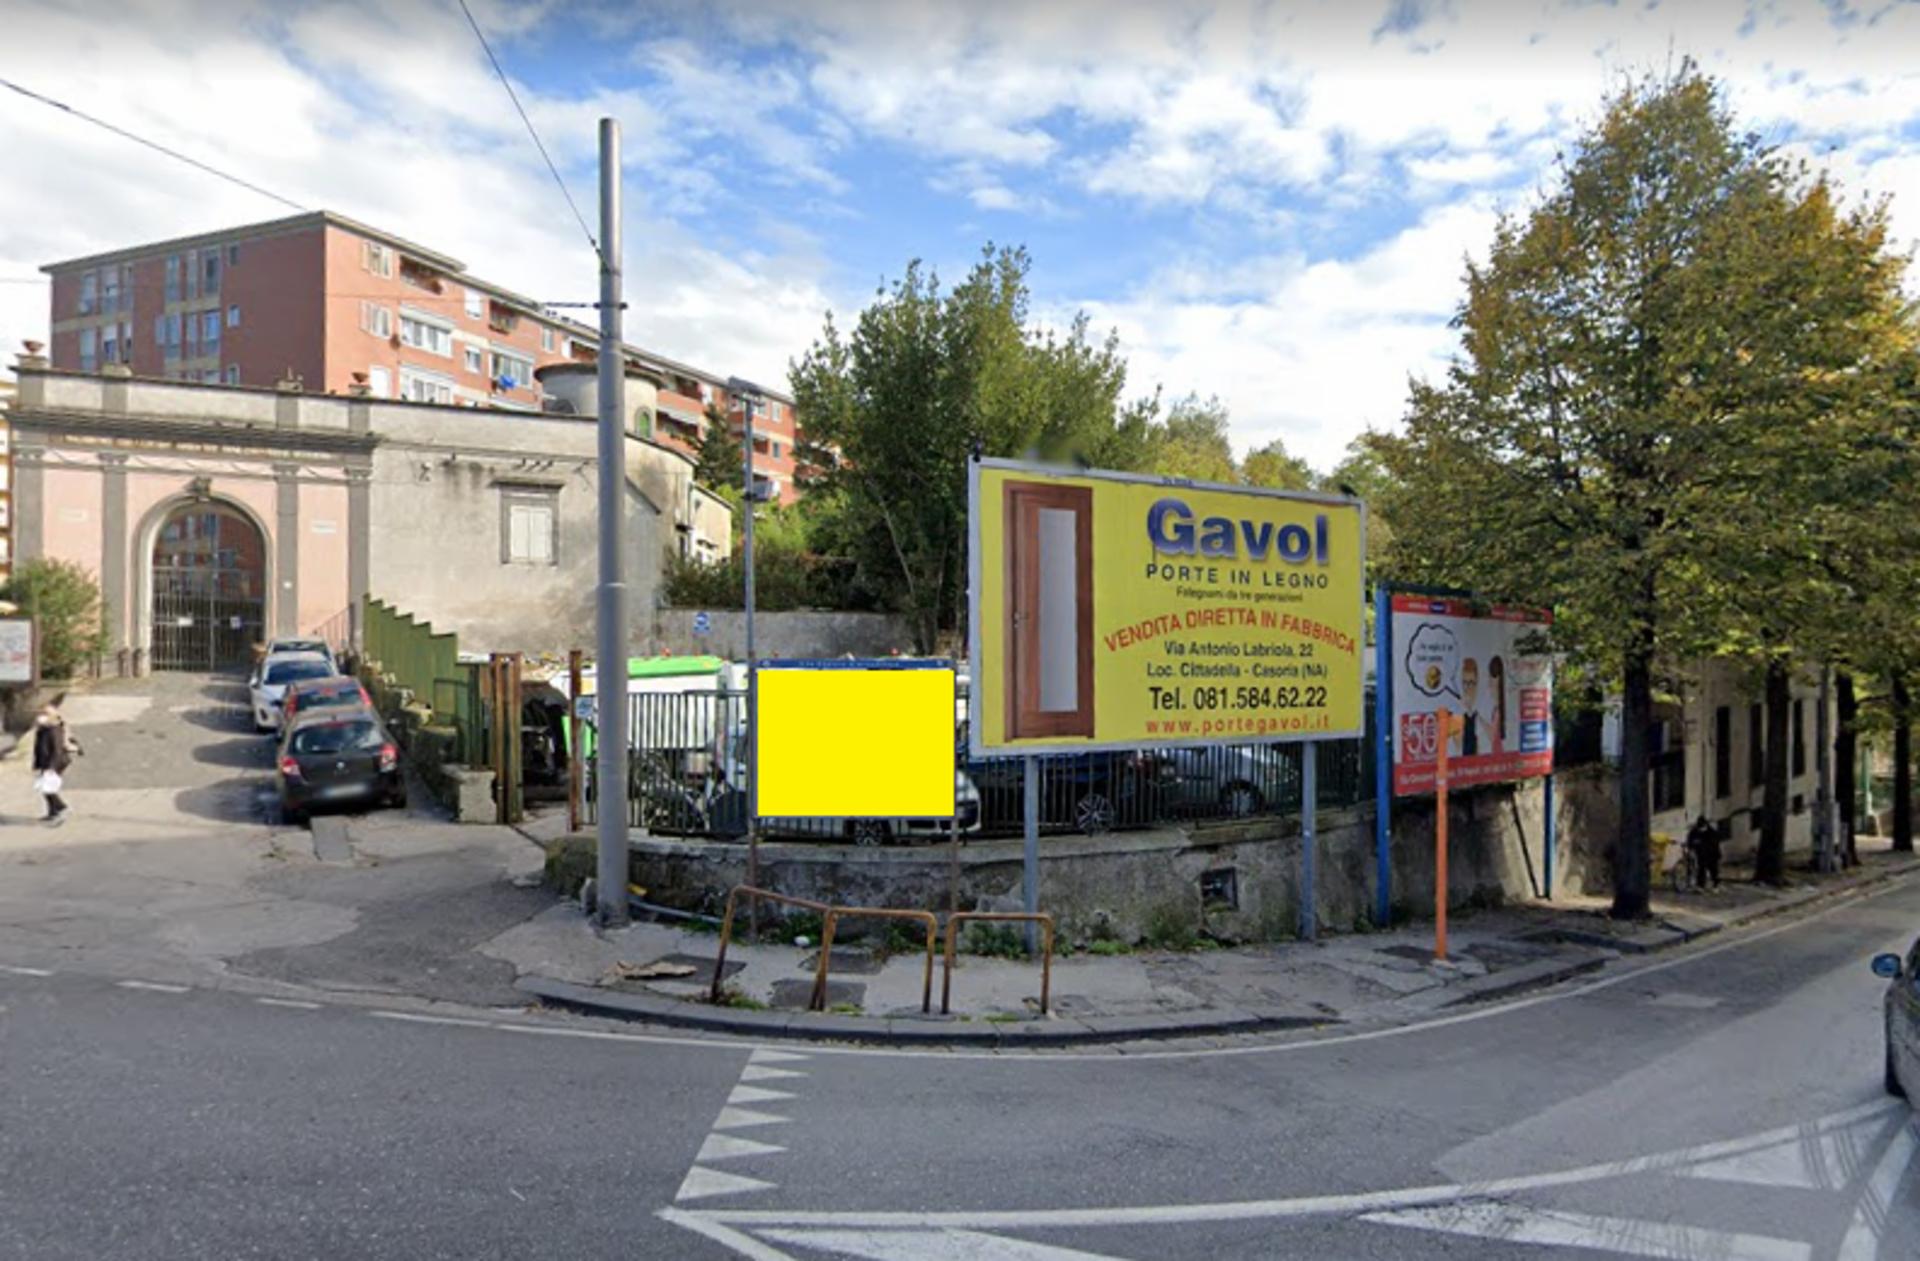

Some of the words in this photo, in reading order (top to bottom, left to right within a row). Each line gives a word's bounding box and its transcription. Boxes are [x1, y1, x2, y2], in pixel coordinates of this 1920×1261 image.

[1147, 498, 1329, 566] Gavol
[1146, 563, 1218, 583] PORTE
[1231, 570, 1250, 584] IN
[1263, 572, 1329, 589] LEGNO
[1104, 613, 1182, 652] VENDITA
[1186, 607, 1257, 629] DIRETTA
[1261, 610, 1276, 628] IN
[1280, 613, 1355, 656] FABBRICA
[1164, 640, 1185, 656] Via
[1189, 641, 1240, 657] Antonio
[1299, 643, 1313, 657] 22
[1302, 663, 1327, 679] (NA)
[1149, 687, 1187, 710] Tel.
[1193, 686, 1327, 710] 081.584.62.22
[1146, 714, 1330, 736] www.portegavol.it
